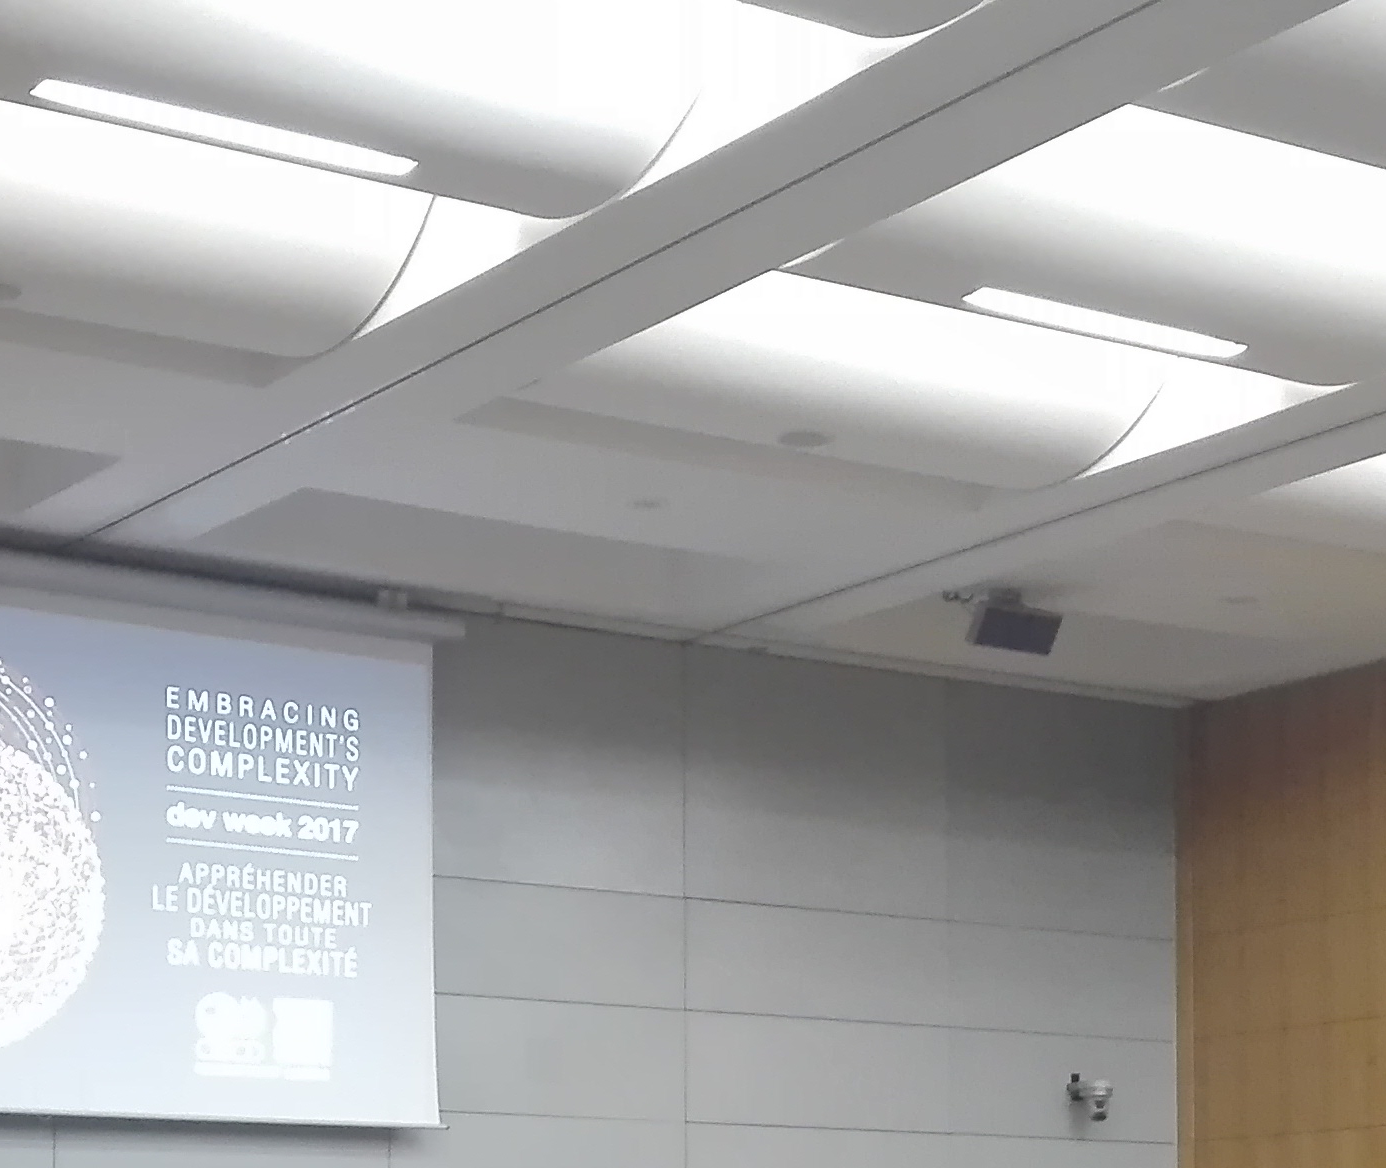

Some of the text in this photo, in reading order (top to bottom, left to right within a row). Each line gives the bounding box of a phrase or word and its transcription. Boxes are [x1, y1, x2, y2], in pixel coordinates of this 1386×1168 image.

[166, 686, 359, 731] EMBRACING
[166, 714, 359, 761] DEVELOPMENT'S
[166, 745, 359, 791] COMPLEXITY
[166, 801, 359, 843] dev week 2017
[178, 862, 347, 897] APPRÉHENDER
[152, 883, 373, 927] LE DÉVELOPPEMENT
[190, 917, 337, 949] DANS TOUTE
[166, 938, 358, 978] SA COMPLEXITÉ
